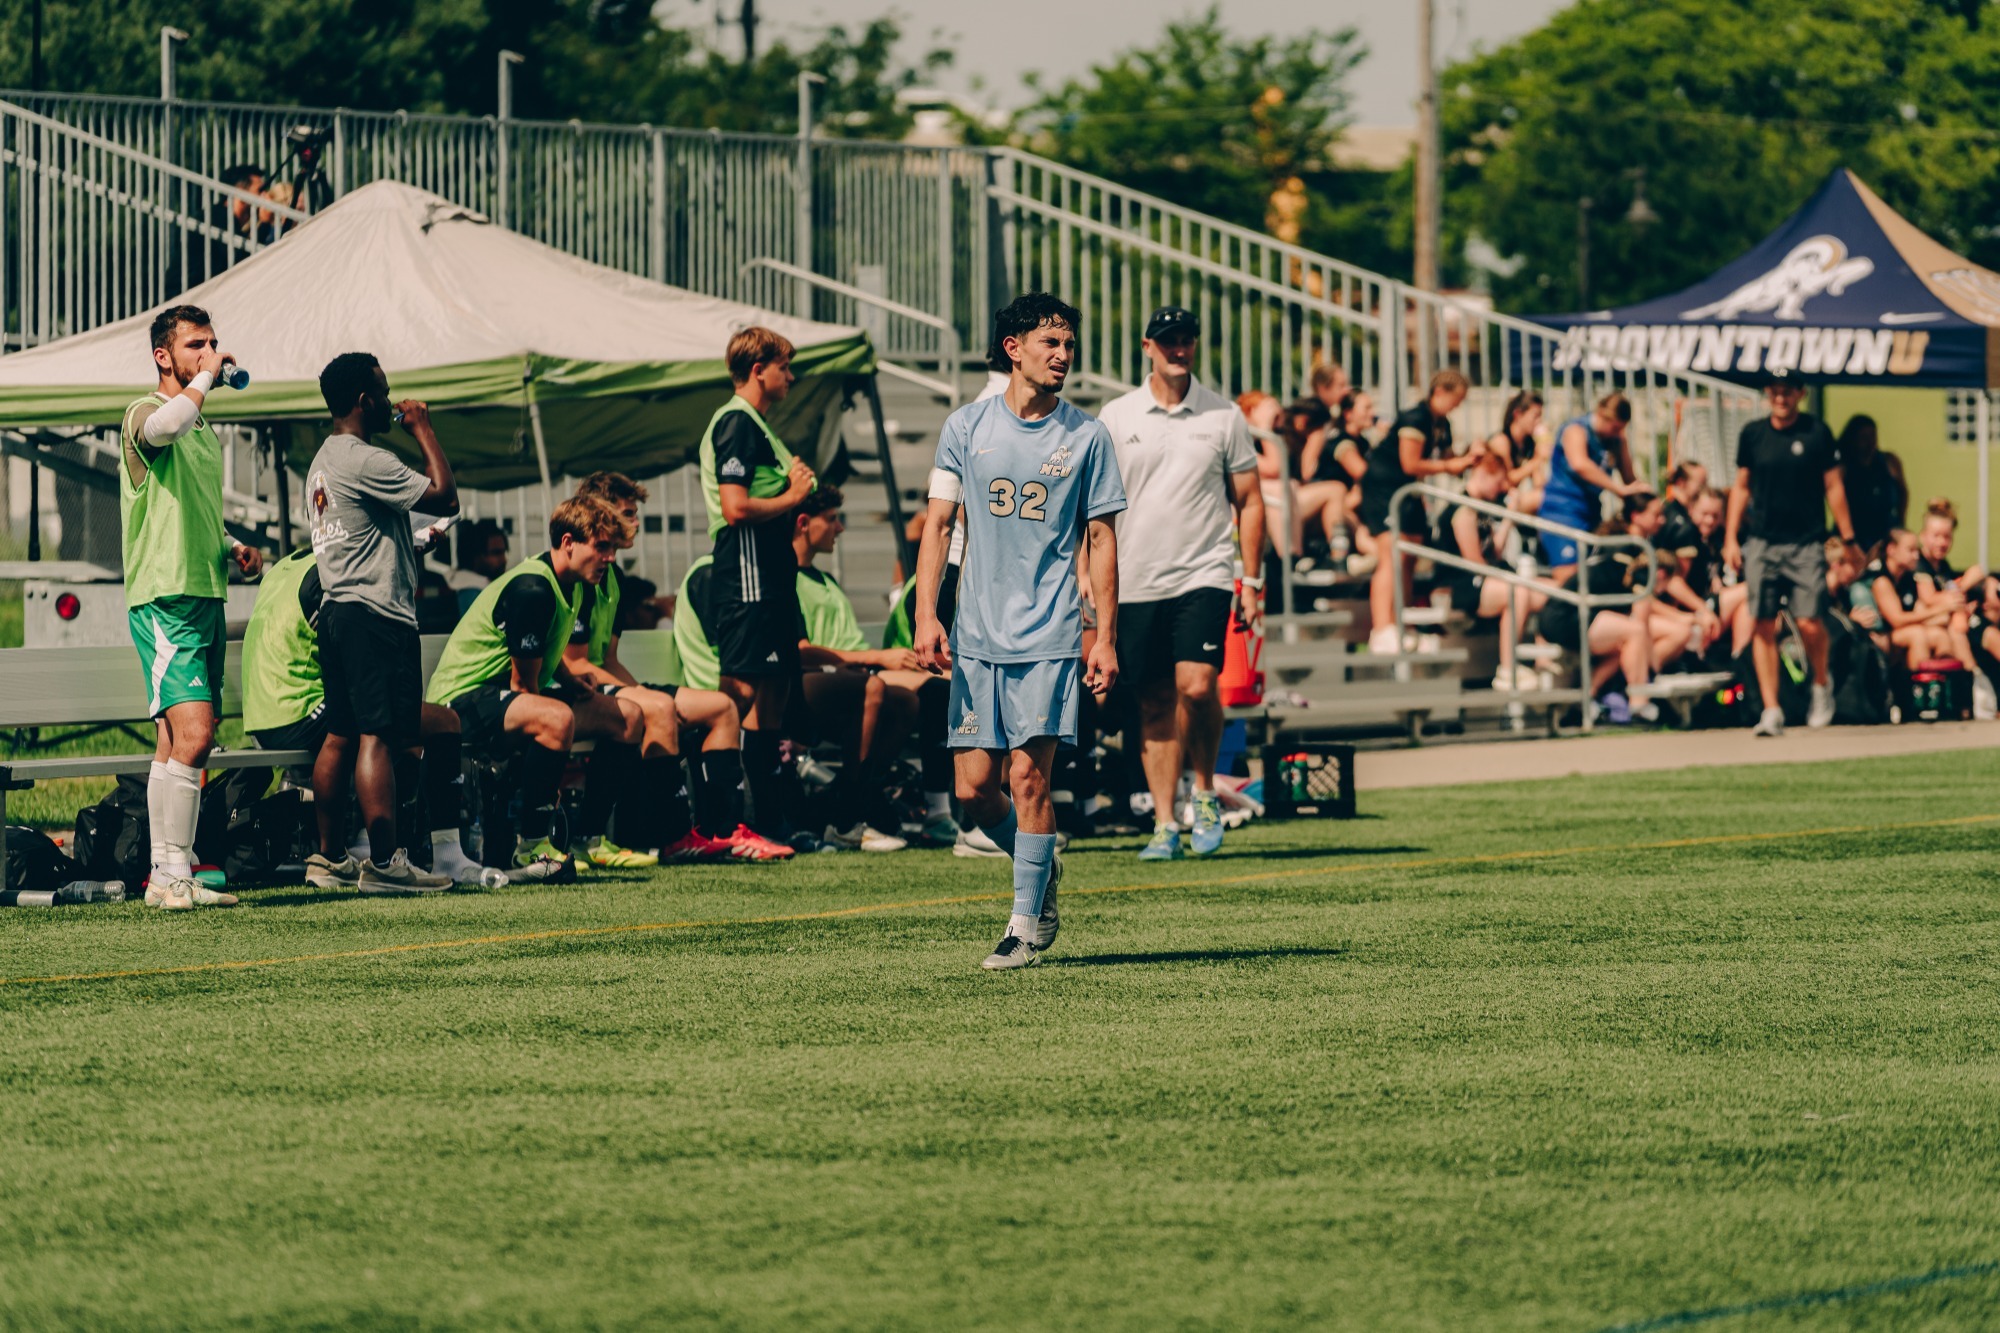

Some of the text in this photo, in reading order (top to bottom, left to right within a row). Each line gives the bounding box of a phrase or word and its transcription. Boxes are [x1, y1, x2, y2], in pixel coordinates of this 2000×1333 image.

[1553, 325, 1930, 375] #DOWNTOWNU
[1039, 463, 1073, 478] NCU
[989, 477, 1048, 522] 32
[957, 725, 979, 735] NCU
